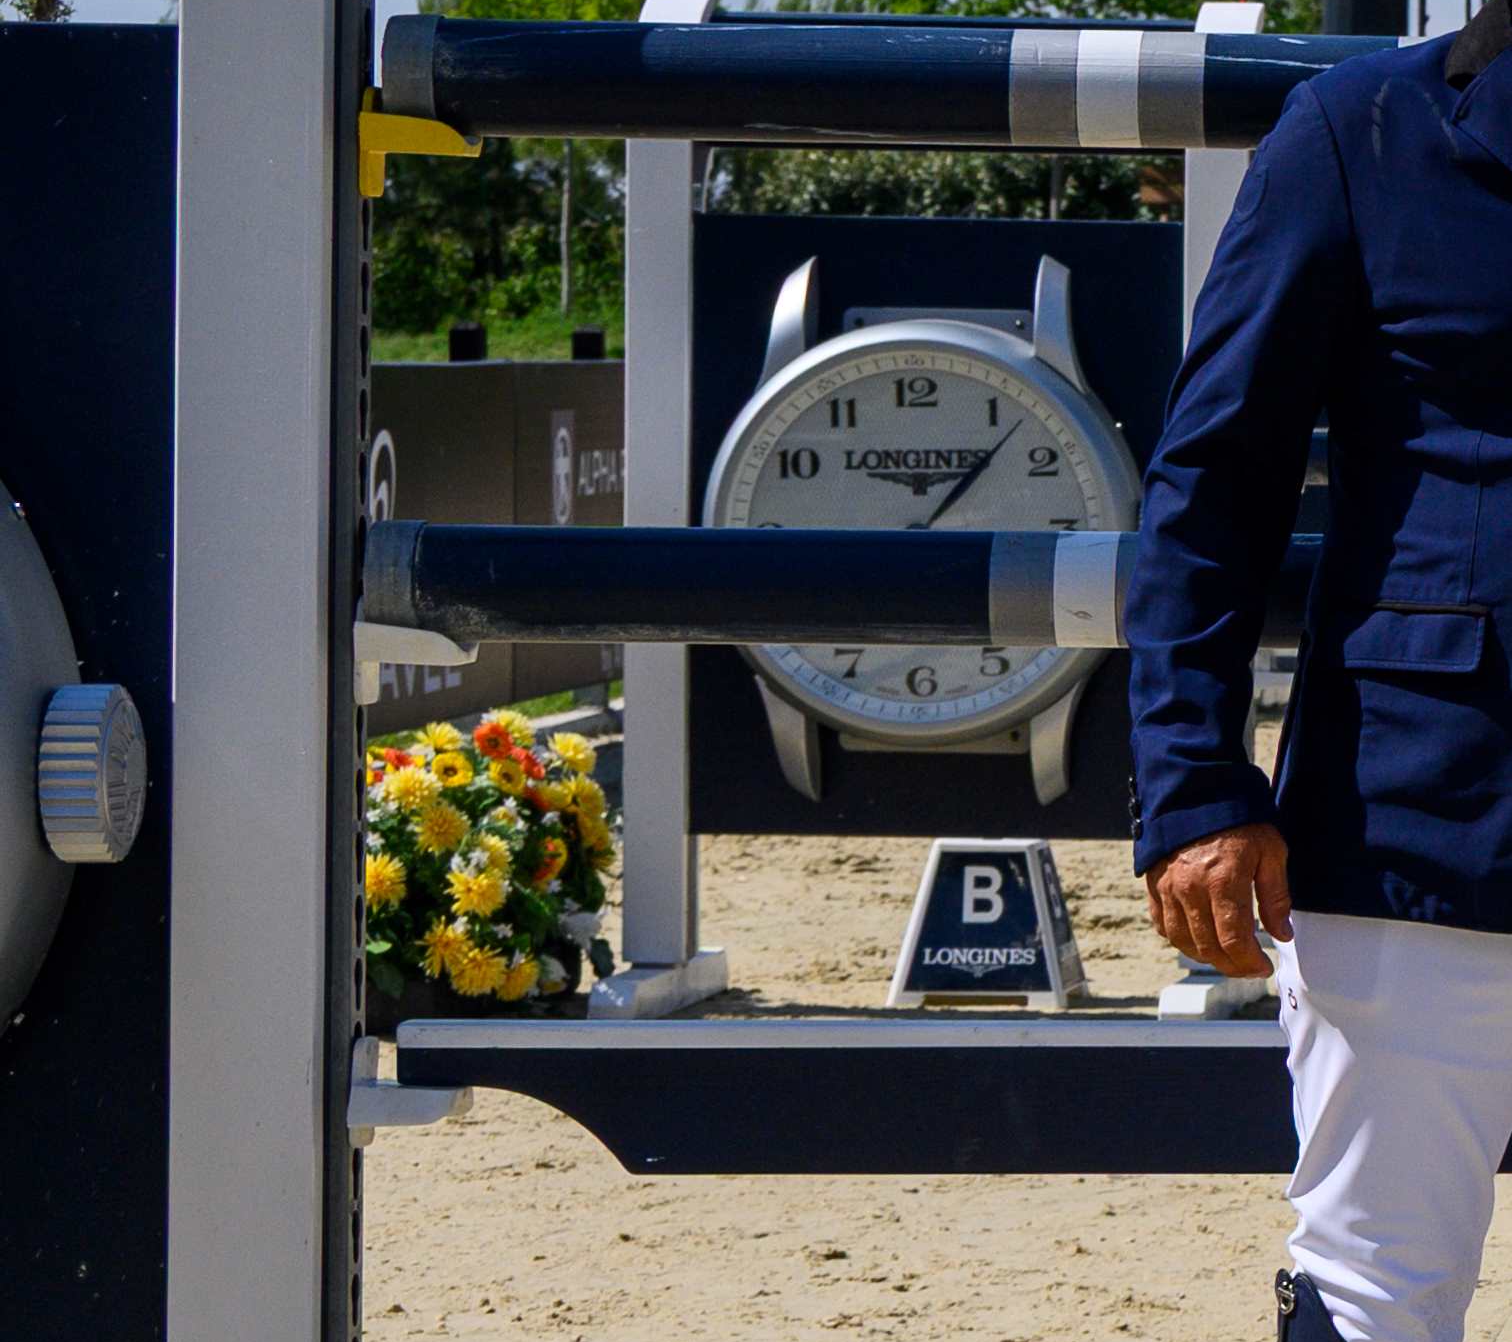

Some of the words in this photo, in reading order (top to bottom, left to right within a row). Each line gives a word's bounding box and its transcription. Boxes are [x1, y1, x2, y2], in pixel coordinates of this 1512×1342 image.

[894, 377, 938, 407] 12
[828, 397, 856, 428] 11
[987, 397, 998, 427] 1
[778, 448, 819, 479] 10
[844, 448, 993, 470] LONGINES
[1028, 446, 1059, 477] 2
[833, 648, 865, 679] 7
[979, 648, 1010, 677] 5
[906, 665, 938, 698] 6
[962, 865, 1004, 923] B
[922, 947, 1037, 966] LONGINES
